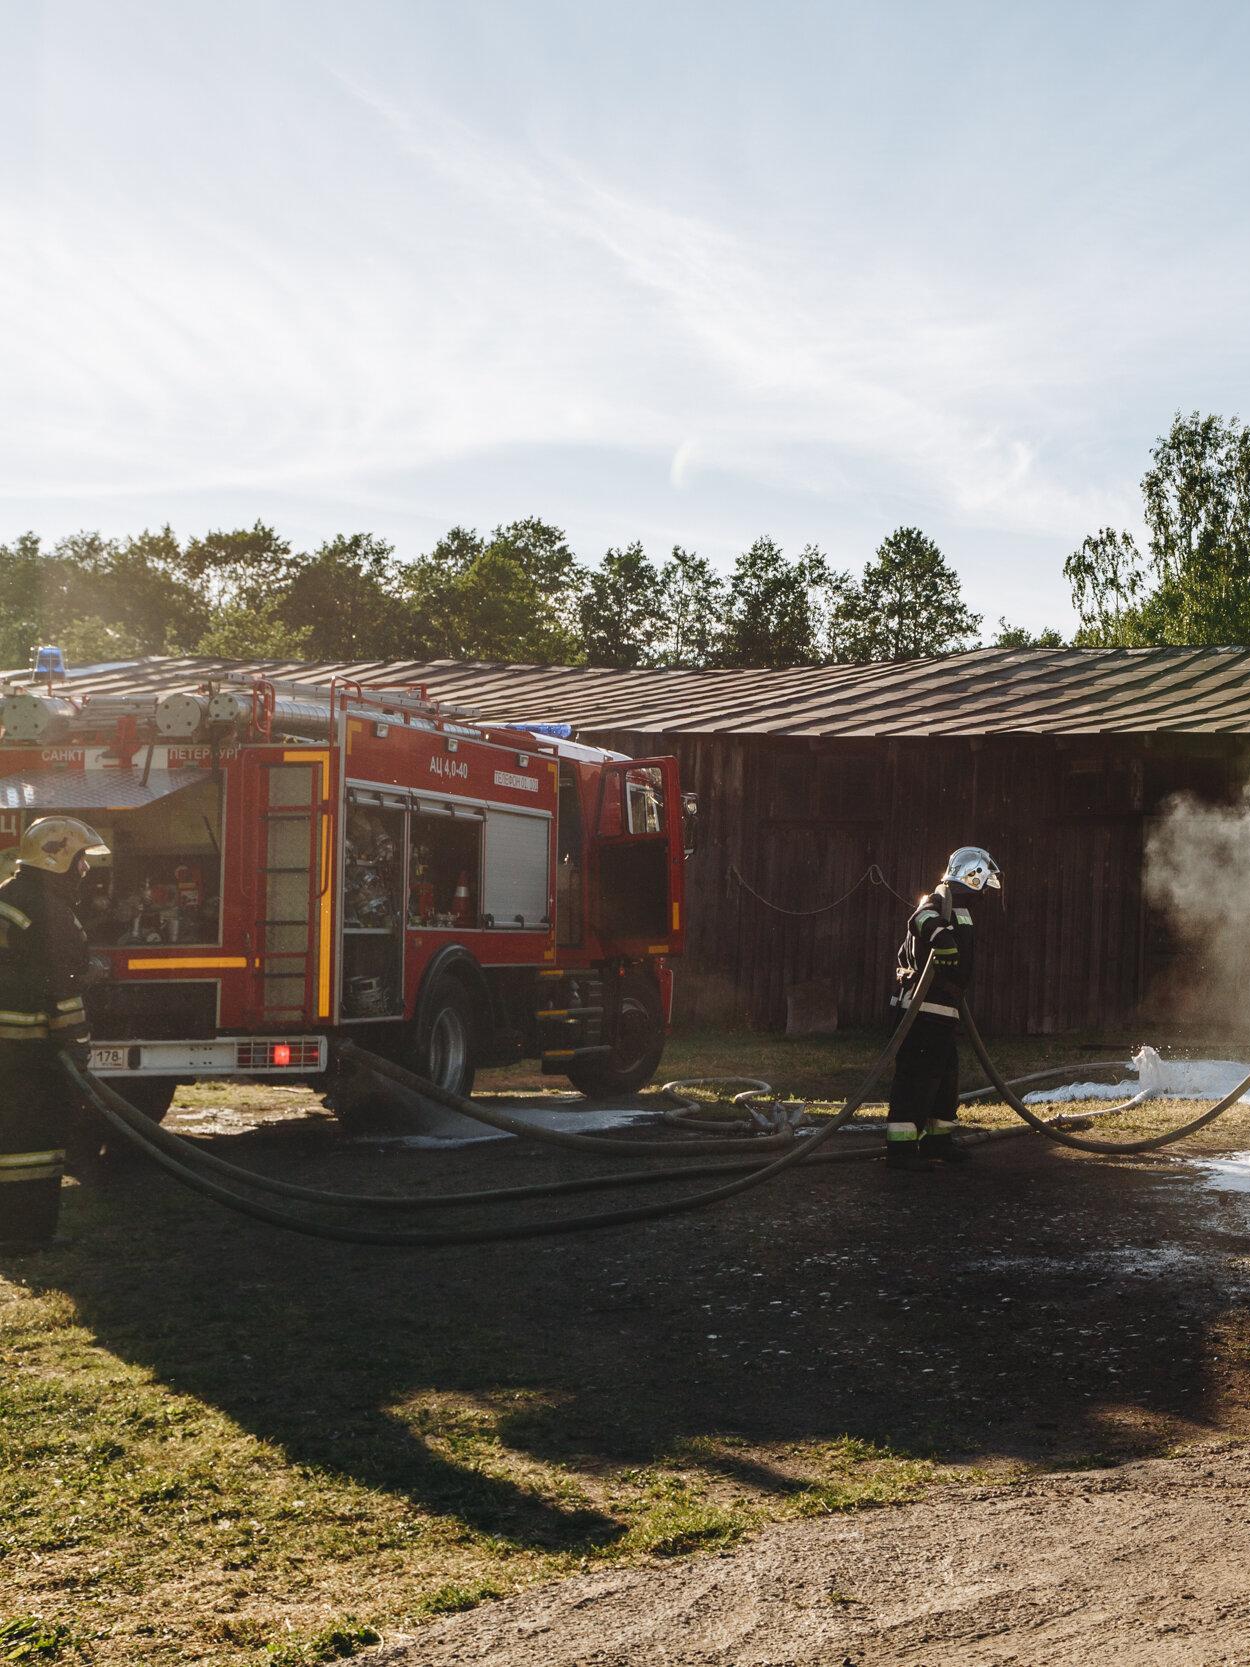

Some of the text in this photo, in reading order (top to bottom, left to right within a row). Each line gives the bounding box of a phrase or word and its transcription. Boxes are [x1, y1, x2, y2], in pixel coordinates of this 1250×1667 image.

[41, 749, 84, 762] САНКТ
[169, 748, 240, 760] ПЕТЕРУРГ
[430, 755, 468, 779] АЦ 4,0-40
[96, 1050, 119, 1062] 178
